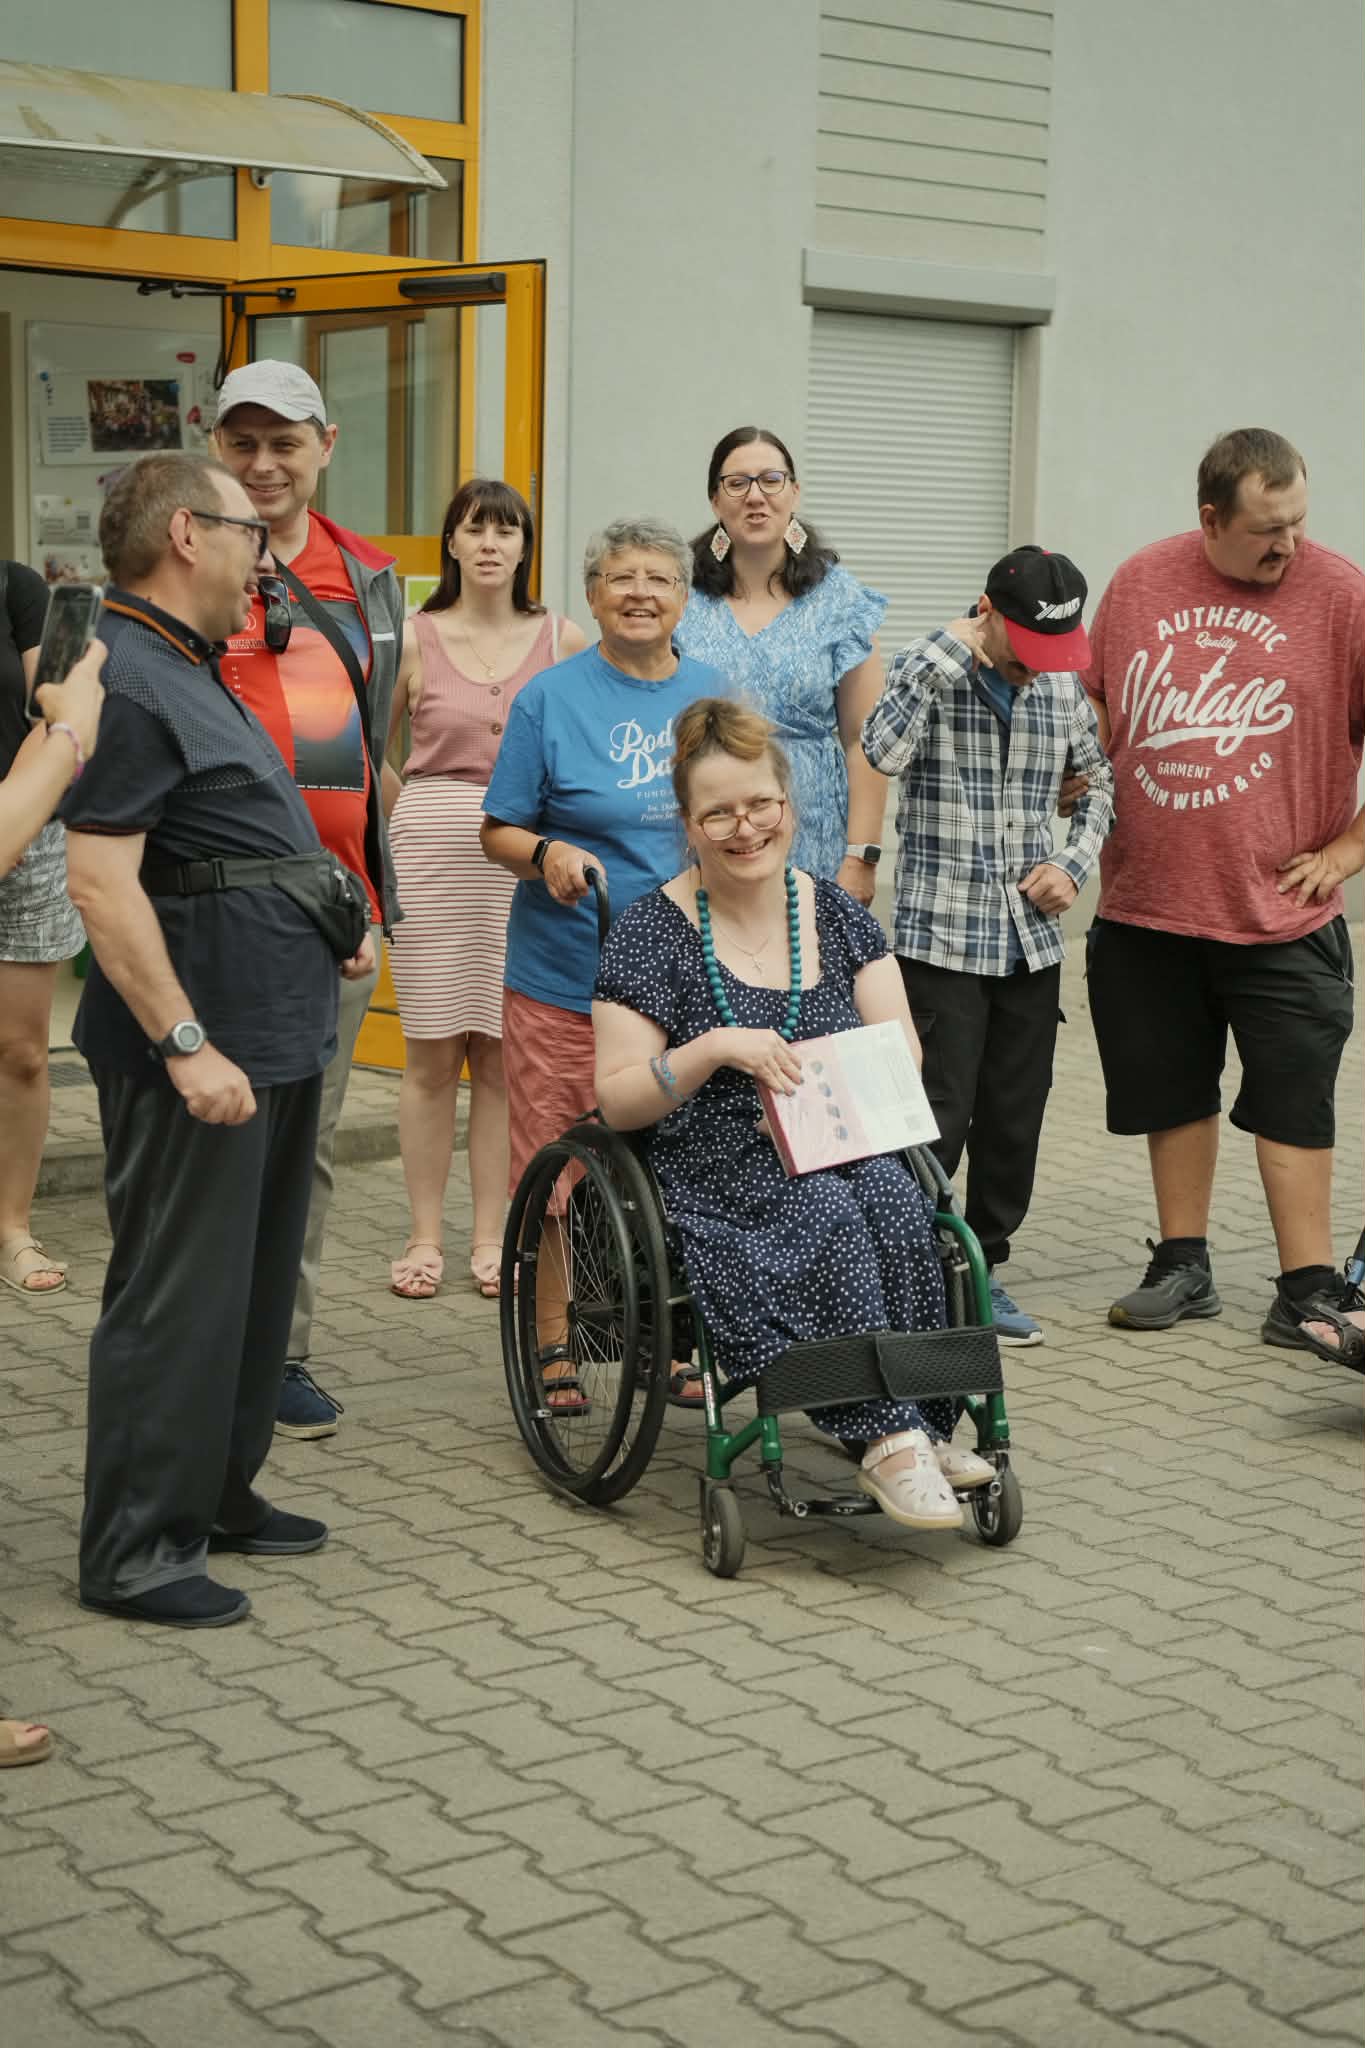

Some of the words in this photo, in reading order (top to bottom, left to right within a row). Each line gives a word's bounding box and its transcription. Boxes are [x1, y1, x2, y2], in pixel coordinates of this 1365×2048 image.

[1158, 606, 1287, 653] AUTHENTIC
[1195, 631, 1238, 654] Quality
[1121, 644, 1294, 756] Vintage
[1134, 764, 1169, 807] DENIM
[1174, 784, 1230, 810] WEAR
[1234, 775, 1249, 792] &
[1250, 752, 1273, 778] CO
[1158, 761, 1212, 779] GARMENT
